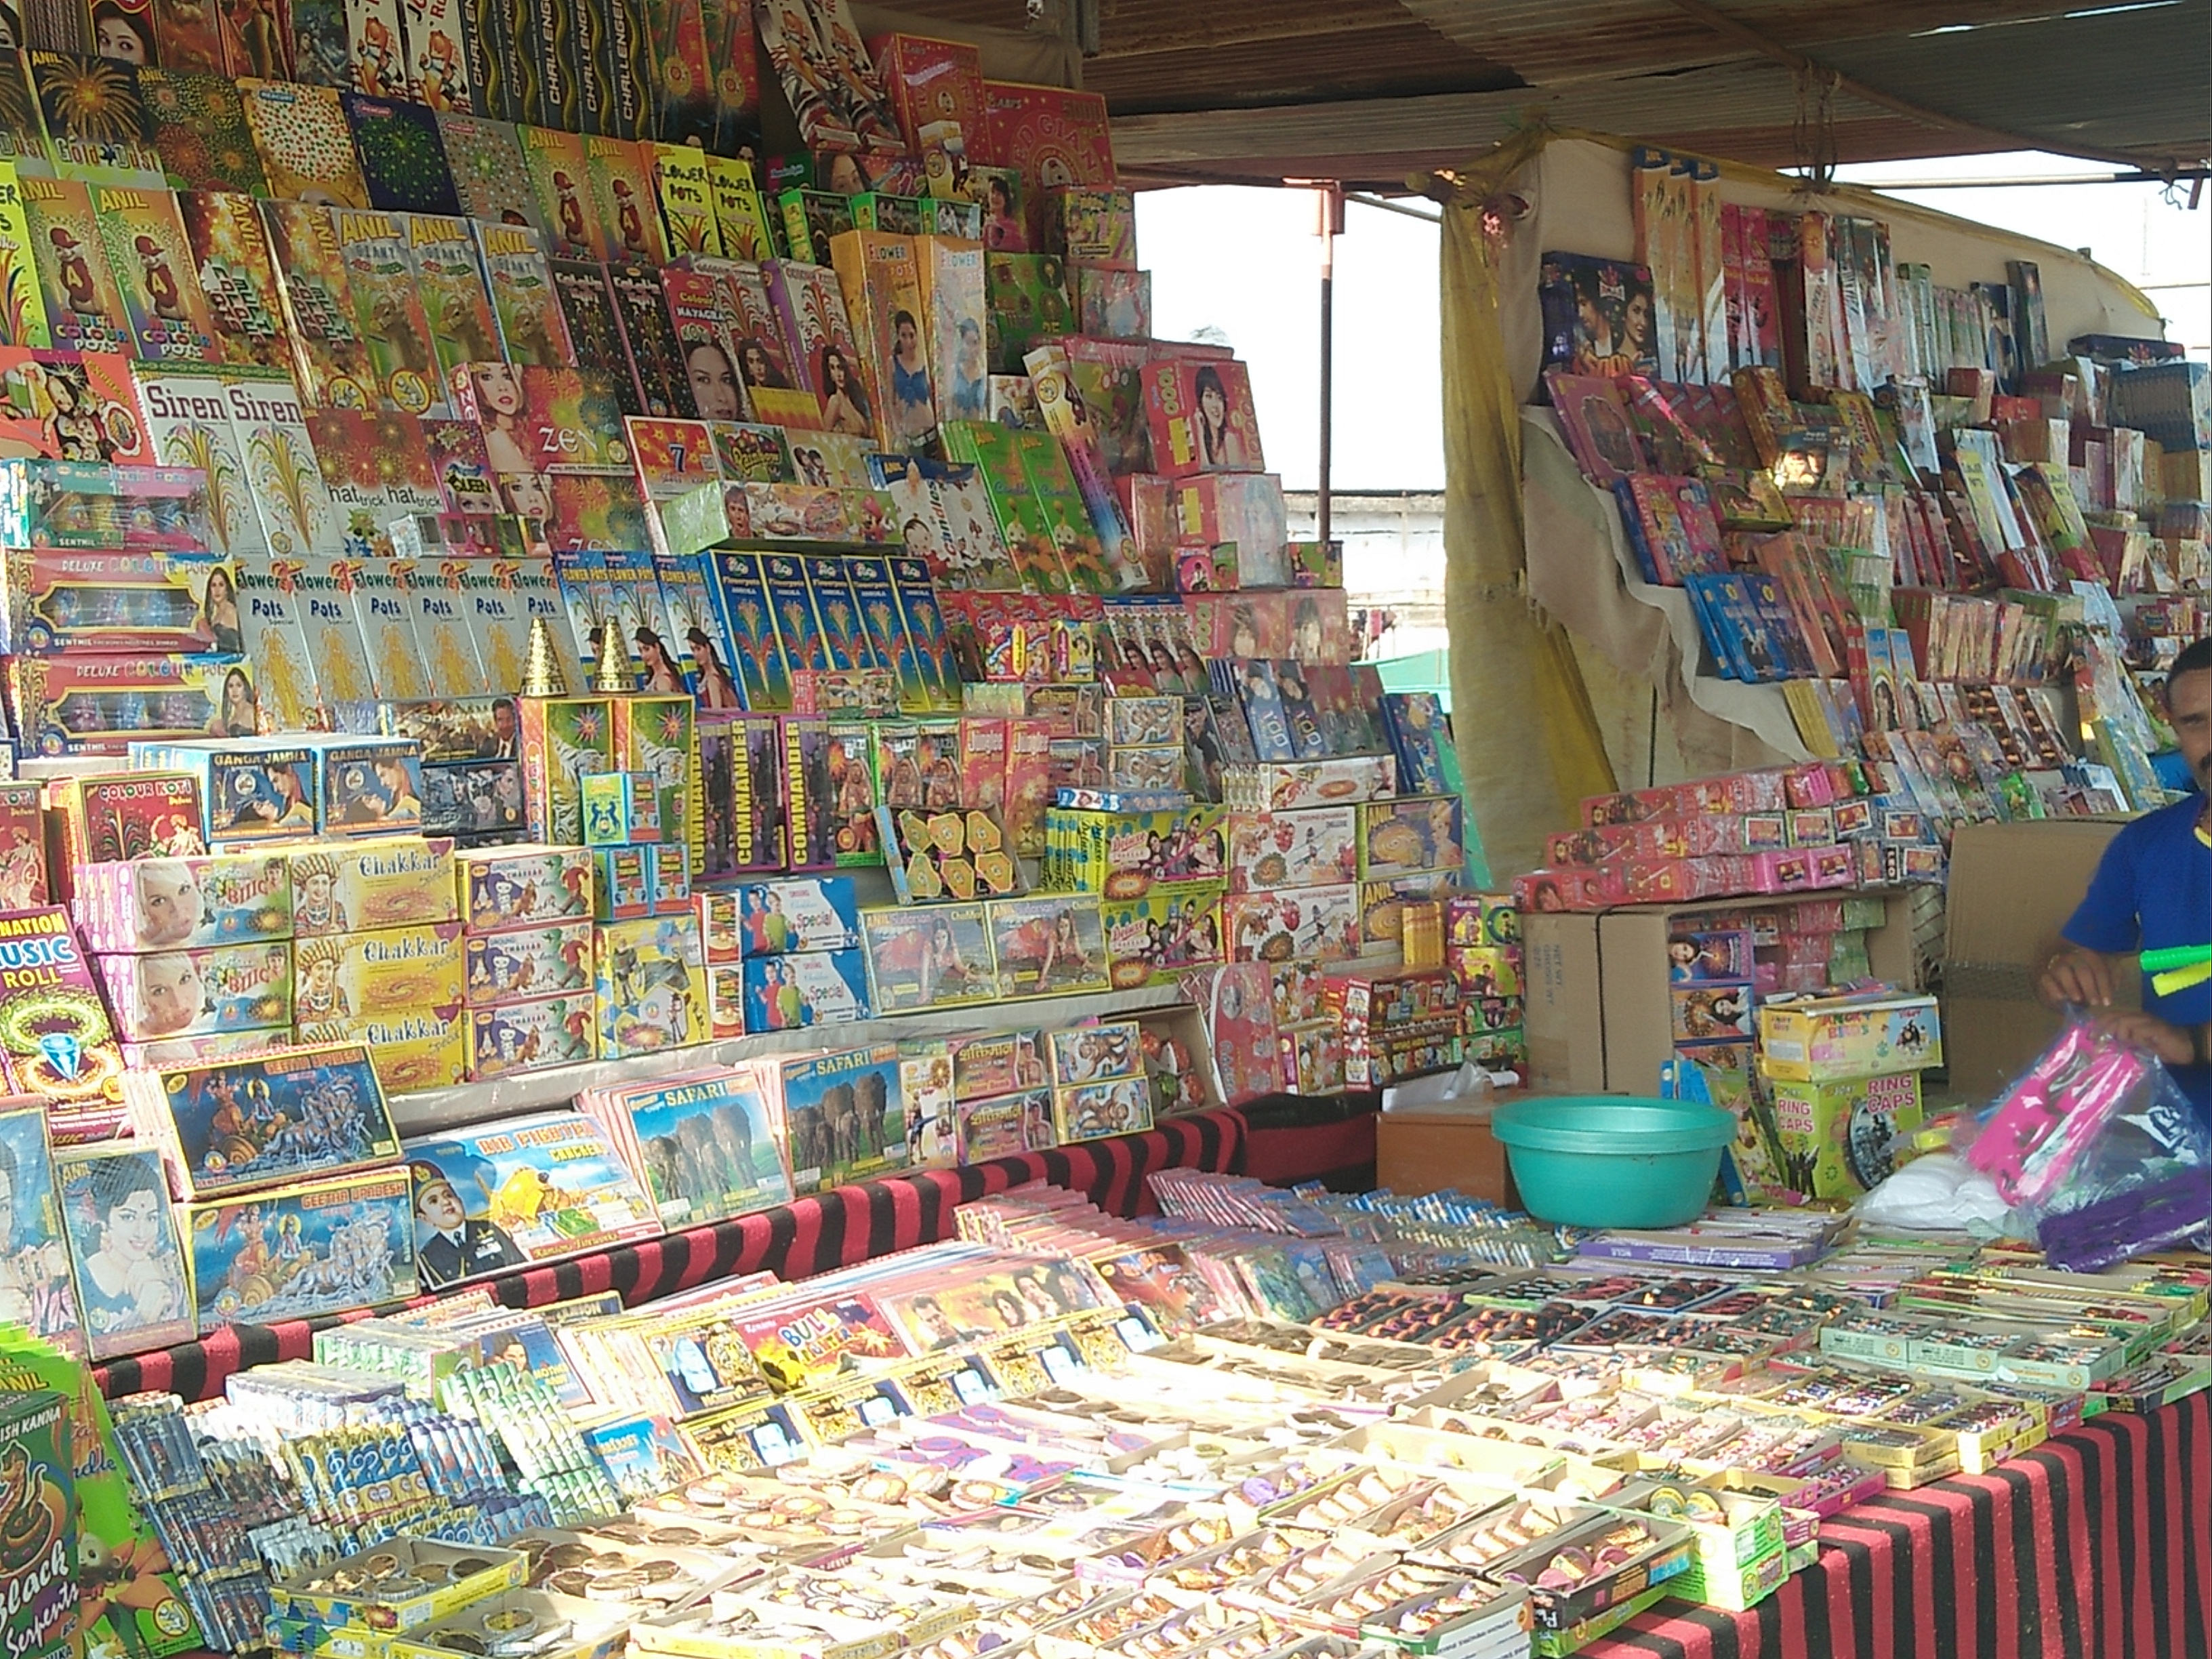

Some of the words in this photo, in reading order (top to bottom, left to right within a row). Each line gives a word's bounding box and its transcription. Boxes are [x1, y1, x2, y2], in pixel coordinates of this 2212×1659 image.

[31, 51, 61, 66] ANIL
[543, 0, 562, 106] CHALLENG
[529, 131, 565, 149] ANIL
[589, 139, 624, 159] ANIL
[55, 136, 101, 166] Gold
[121, 144, 159, 172] Dust
[99, 189, 149, 213] ANIL
[669, 184, 702, 203] POTS
[718, 192, 752, 211] POTS
[230, 198, 258, 252] ANIL
[341, 212, 402, 247] ANIL
[409, 216, 468, 249] ANIL
[483, 227, 538, 257] ANIL
[869, 243, 907, 262] FLOWER
[56, 327, 127, 342] COLOUR
[142, 329, 210, 347] COLOUR
[74, 339, 119, 354] POTS
[161, 342, 204, 358] POTS
[147, 385, 228, 419] Siren
[228, 389, 305, 424] Siren
[328, 485, 359, 506] hat
[386, 486, 417, 506] hat
[62, 560, 104, 573] DELUXE
[252, 597, 285, 619] Pots
[310, 599, 343, 619] Pots
[371, 596, 401, 617] Pots
[422, 596, 452, 616] Pots
[476, 596, 506, 616] Pots
[527, 596, 556, 616] Pots
[54, 637, 93, 648] SENTHIL
[77, 665, 119, 678] DELUXE
[67, 743, 106, 754] SENTHIL
[214, 752, 260, 765] GANGA
[99, 783, 152, 800] COLOUR
[732, 720, 753, 866] COMMANDER
[787, 721, 811, 866] COMMANDER
[359, 846, 440, 878] Chakkar
[796, 909, 833, 933] Special
[364, 936, 449, 963] Chakkar
[5, 969, 63, 989] ROLL
[809, 982, 844, 1005] Special
[366, 1017, 449, 1046] Chakkar
[816, 1049, 872, 1076] SAFARI
[1868, 1074, 1913, 1094] RING
[663, 1081, 727, 1109] SAFARI
[1867, 1092, 1916, 1113] CAPS
[1778, 1099, 1811, 1115] RING
[1778, 1115, 1814, 1133] CAPS
[477, 1135, 513, 1156] AIR
[302, 1191, 350, 1210] GEETHA
[779, 1307, 842, 1348] BULL
[5, 1580, 80, 1658] Serpents
